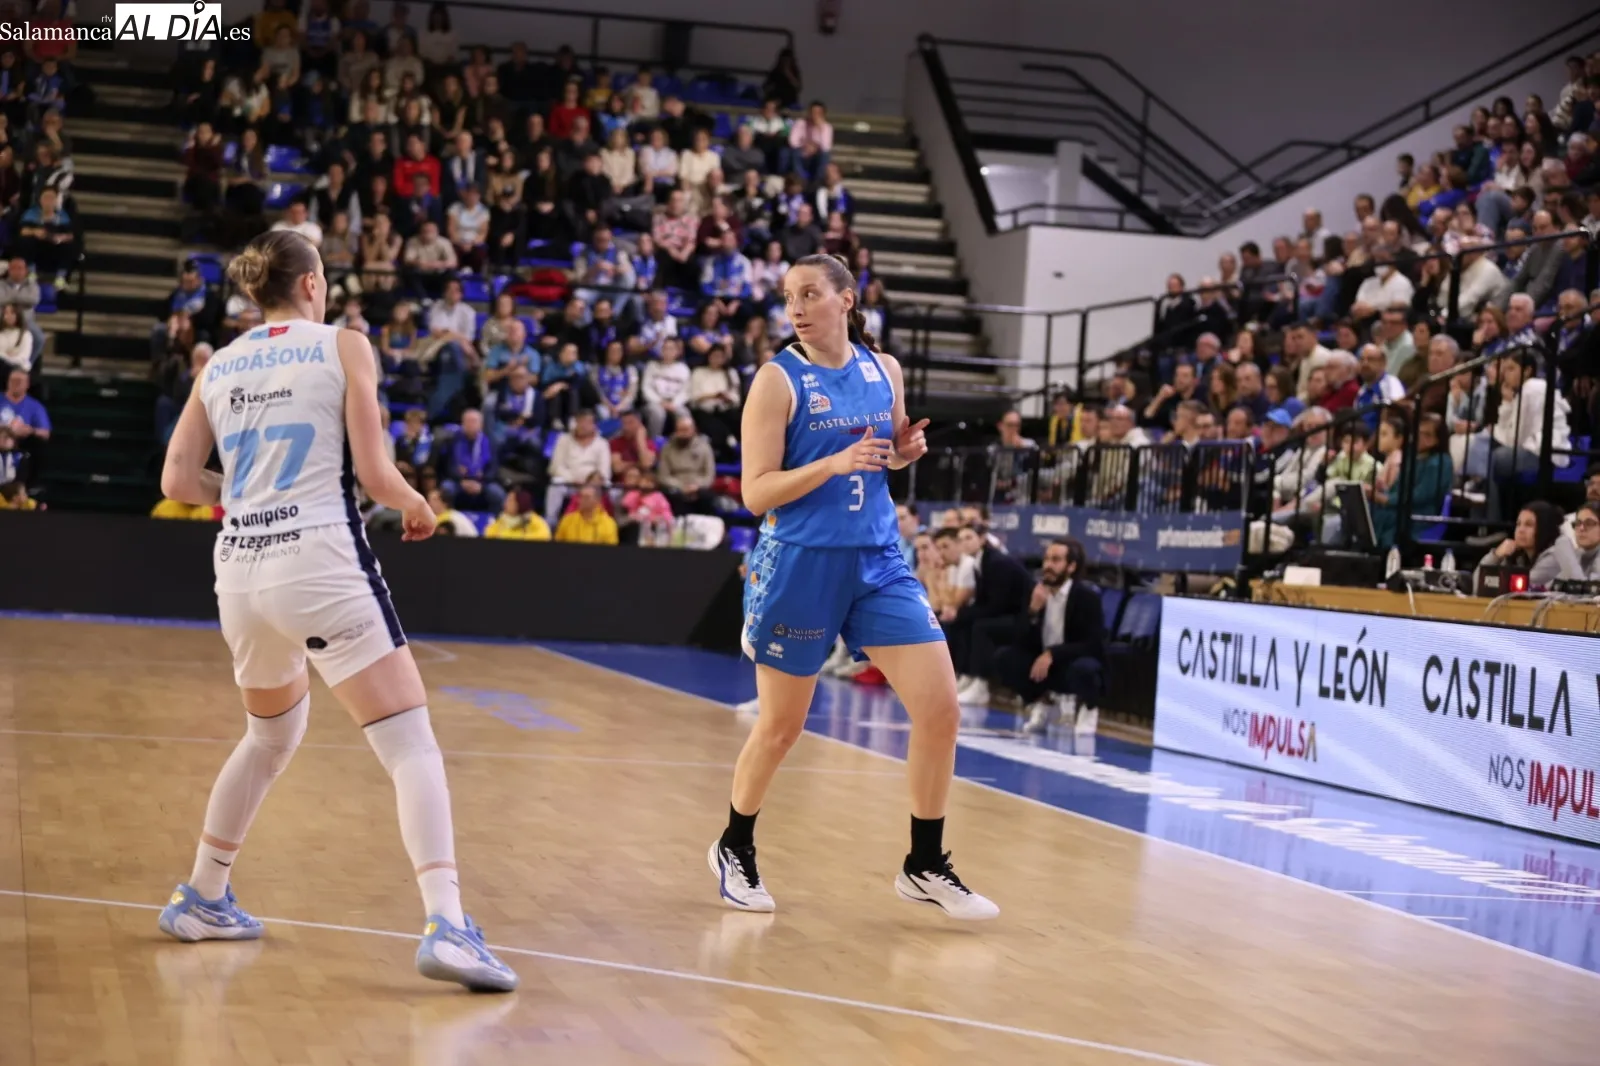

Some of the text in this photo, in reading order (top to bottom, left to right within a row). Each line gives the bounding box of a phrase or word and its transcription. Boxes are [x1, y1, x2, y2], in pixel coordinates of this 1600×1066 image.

[208, 341, 325, 382] DUDÁŠOVÁ
[247, 388, 293, 404] Leganés
[809, 416, 860, 431] CASTILLA
[864, 414, 870, 424] Y
[223, 423, 316, 498] 77
[242, 505, 299, 527] unipiso
[849, 475, 865, 511] 3
[1177, 626, 1389, 708] CASTILLA Y LEÓN
[1422, 654, 1573, 737] CASTILLA
[1223, 708, 1317, 763] NOS IMPULSA
[1488, 753, 1600, 822] NOS IMPUL
